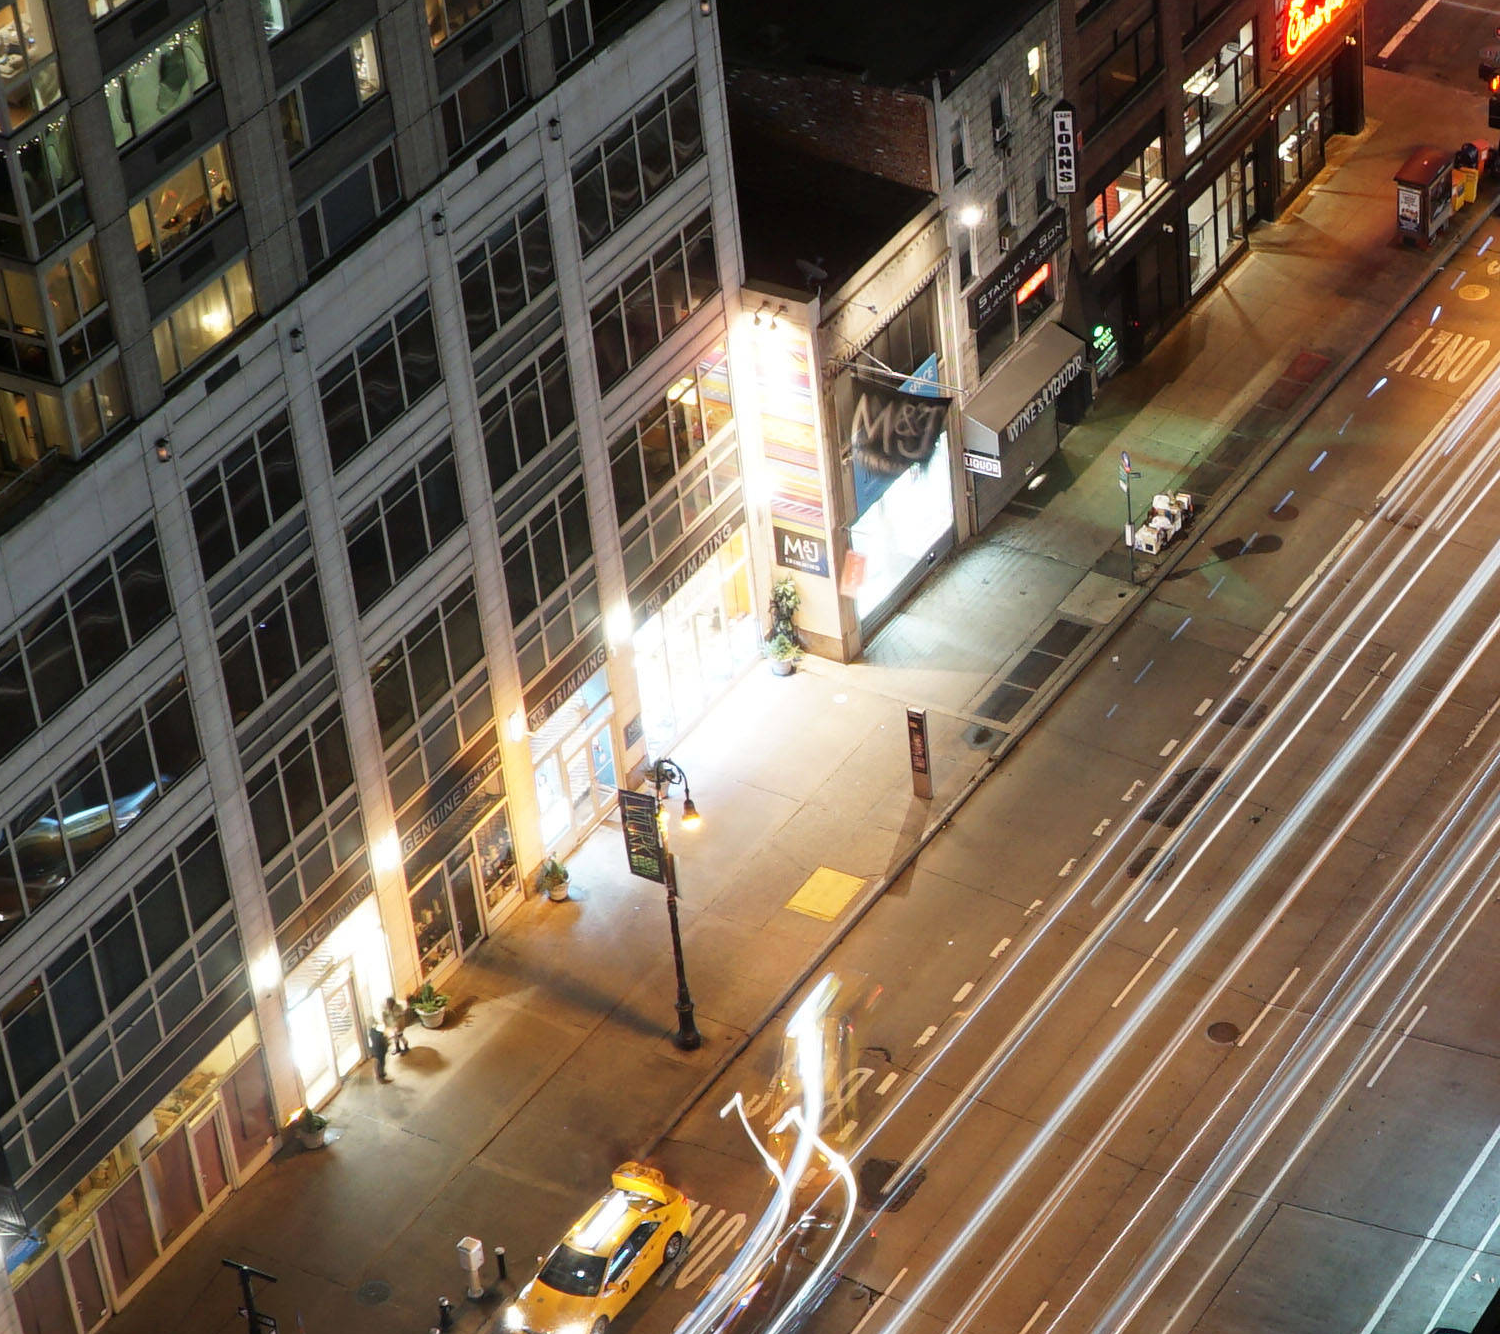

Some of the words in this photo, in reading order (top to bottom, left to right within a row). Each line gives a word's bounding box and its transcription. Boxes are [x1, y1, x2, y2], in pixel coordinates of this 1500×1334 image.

[1057, 120, 1072, 182] LOANS
[978, 257, 1026, 309] STANLEY
[1038, 221, 1063, 249] SON
[1384, 328, 1491, 383] ONLY
[1006, 406, 1037, 443] WINE
[1042, 355, 1082, 404] LIQUOR
[964, 455, 999, 473] LIQUOR
[665, 523, 733, 598] TRIMMING
[784, 535, 820, 564] M&J
[550, 648, 607, 710] TRIMMING
[403, 789, 462, 853] GENUINE
[463, 772, 481, 794] TEN
[482, 755, 500, 774] TEN
[284, 922, 327, 967] GNC
